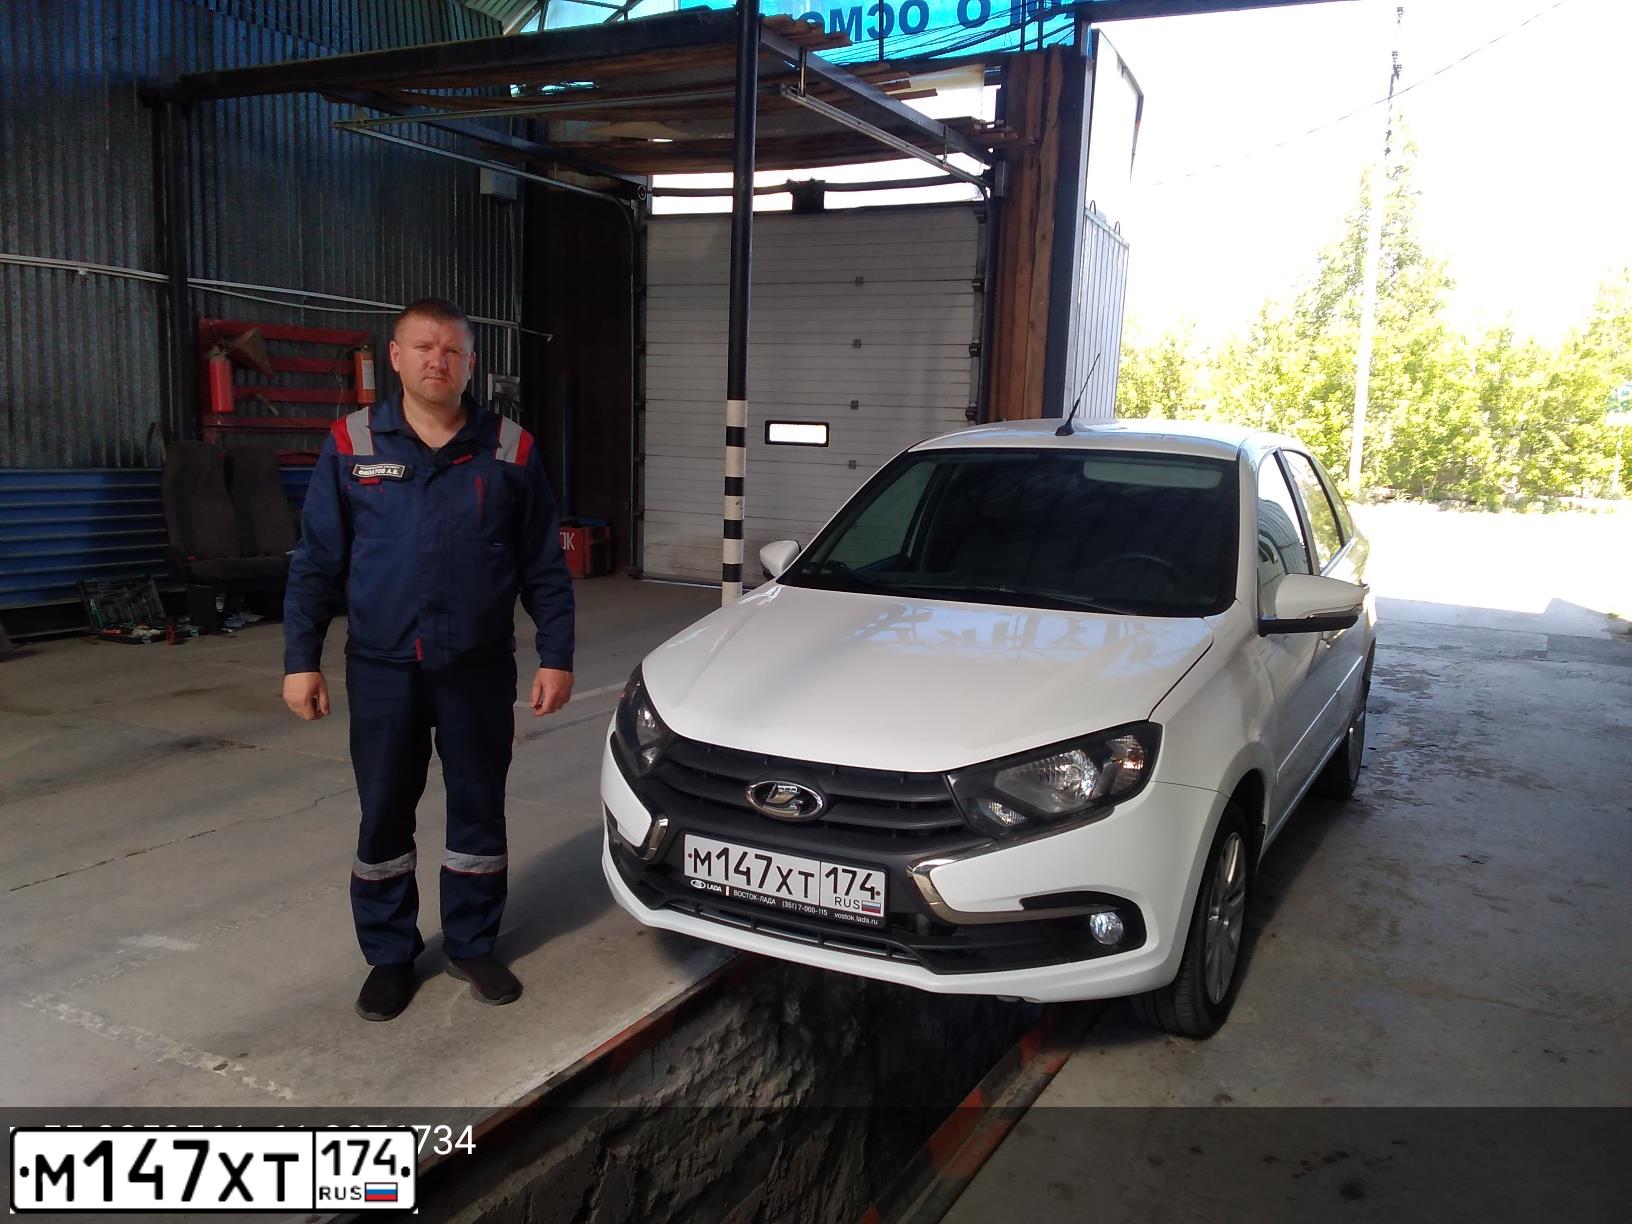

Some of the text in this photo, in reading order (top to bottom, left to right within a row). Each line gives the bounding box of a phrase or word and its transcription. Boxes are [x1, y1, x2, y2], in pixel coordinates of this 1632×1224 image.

[693, 847, 876, 900] М147ХТ 174
[706, 883, 723, 893] LADA
[733, 889, 776, 905] ВОСТОК-ЛАДА
[834, 896, 860, 910] RUS
[834, 911, 879, 925] vostok.lada.ru
